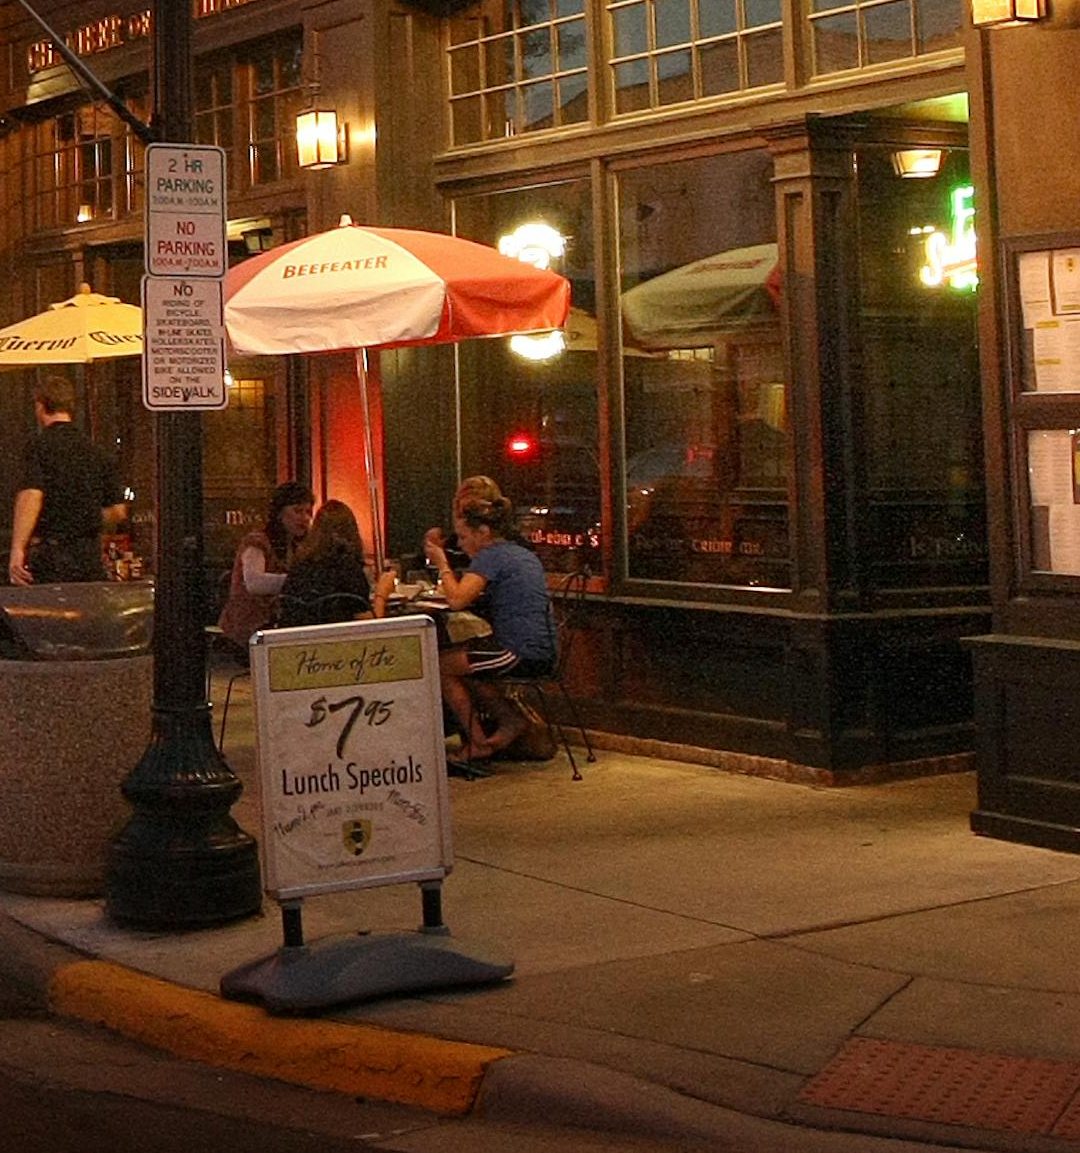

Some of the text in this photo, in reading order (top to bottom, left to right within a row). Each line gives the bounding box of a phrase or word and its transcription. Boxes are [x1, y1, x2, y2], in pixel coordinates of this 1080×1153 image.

[168, 158, 203, 174] 2 HR
[157, 177, 214, 194] PARKING
[176, 221, 195, 235] NO
[157, 240, 215, 256] PARKING
[282, 255, 388, 280] BEEFEATER
[173, 285, 193, 296] NO
[88, 330, 143, 346] Cuer
[295, 644, 396, 681] Home of the
[282, 755, 423, 796] Lunch Specials
